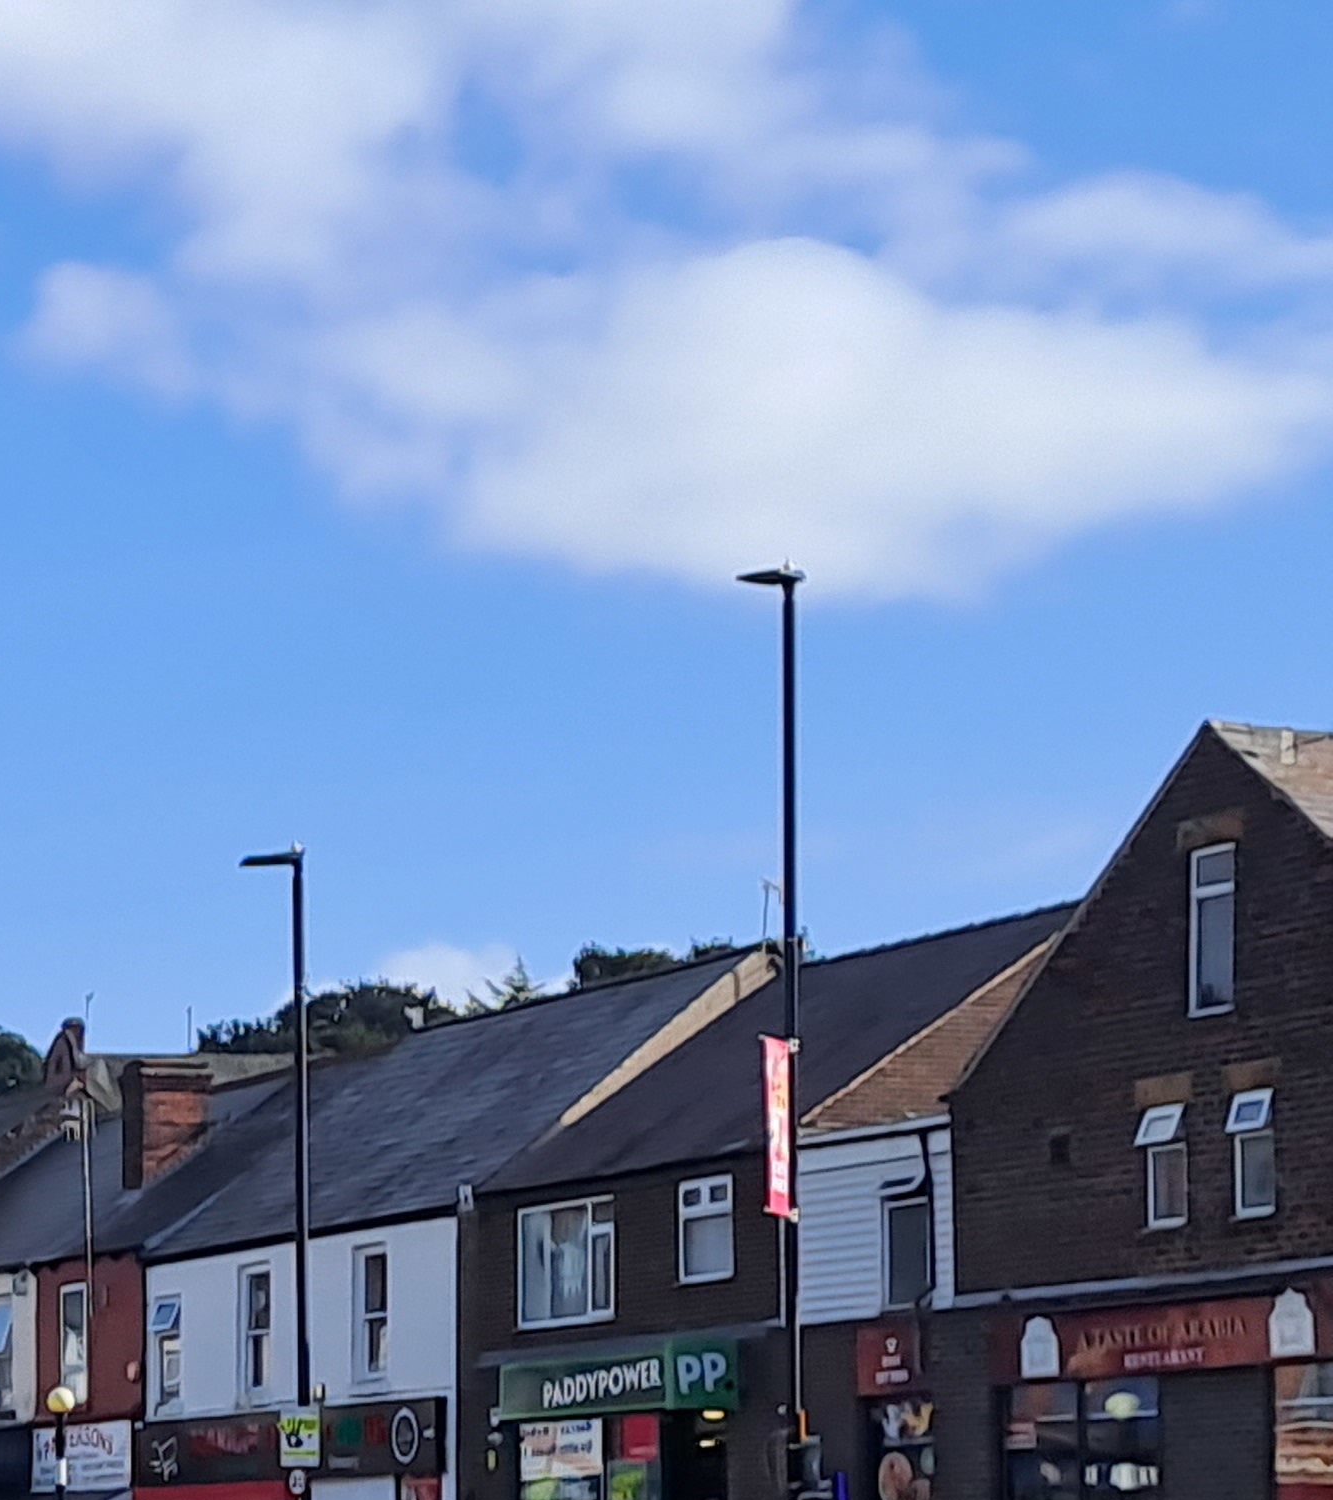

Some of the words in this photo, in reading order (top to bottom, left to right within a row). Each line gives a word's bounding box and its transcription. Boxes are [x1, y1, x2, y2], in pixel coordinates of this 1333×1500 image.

[1094, 1324, 1141, 1348] TASTE
[1177, 1316, 1246, 1342] ARABIA
[542, 1358, 662, 1408] PADDYPOWER
[677, 1352, 727, 1394] PP
